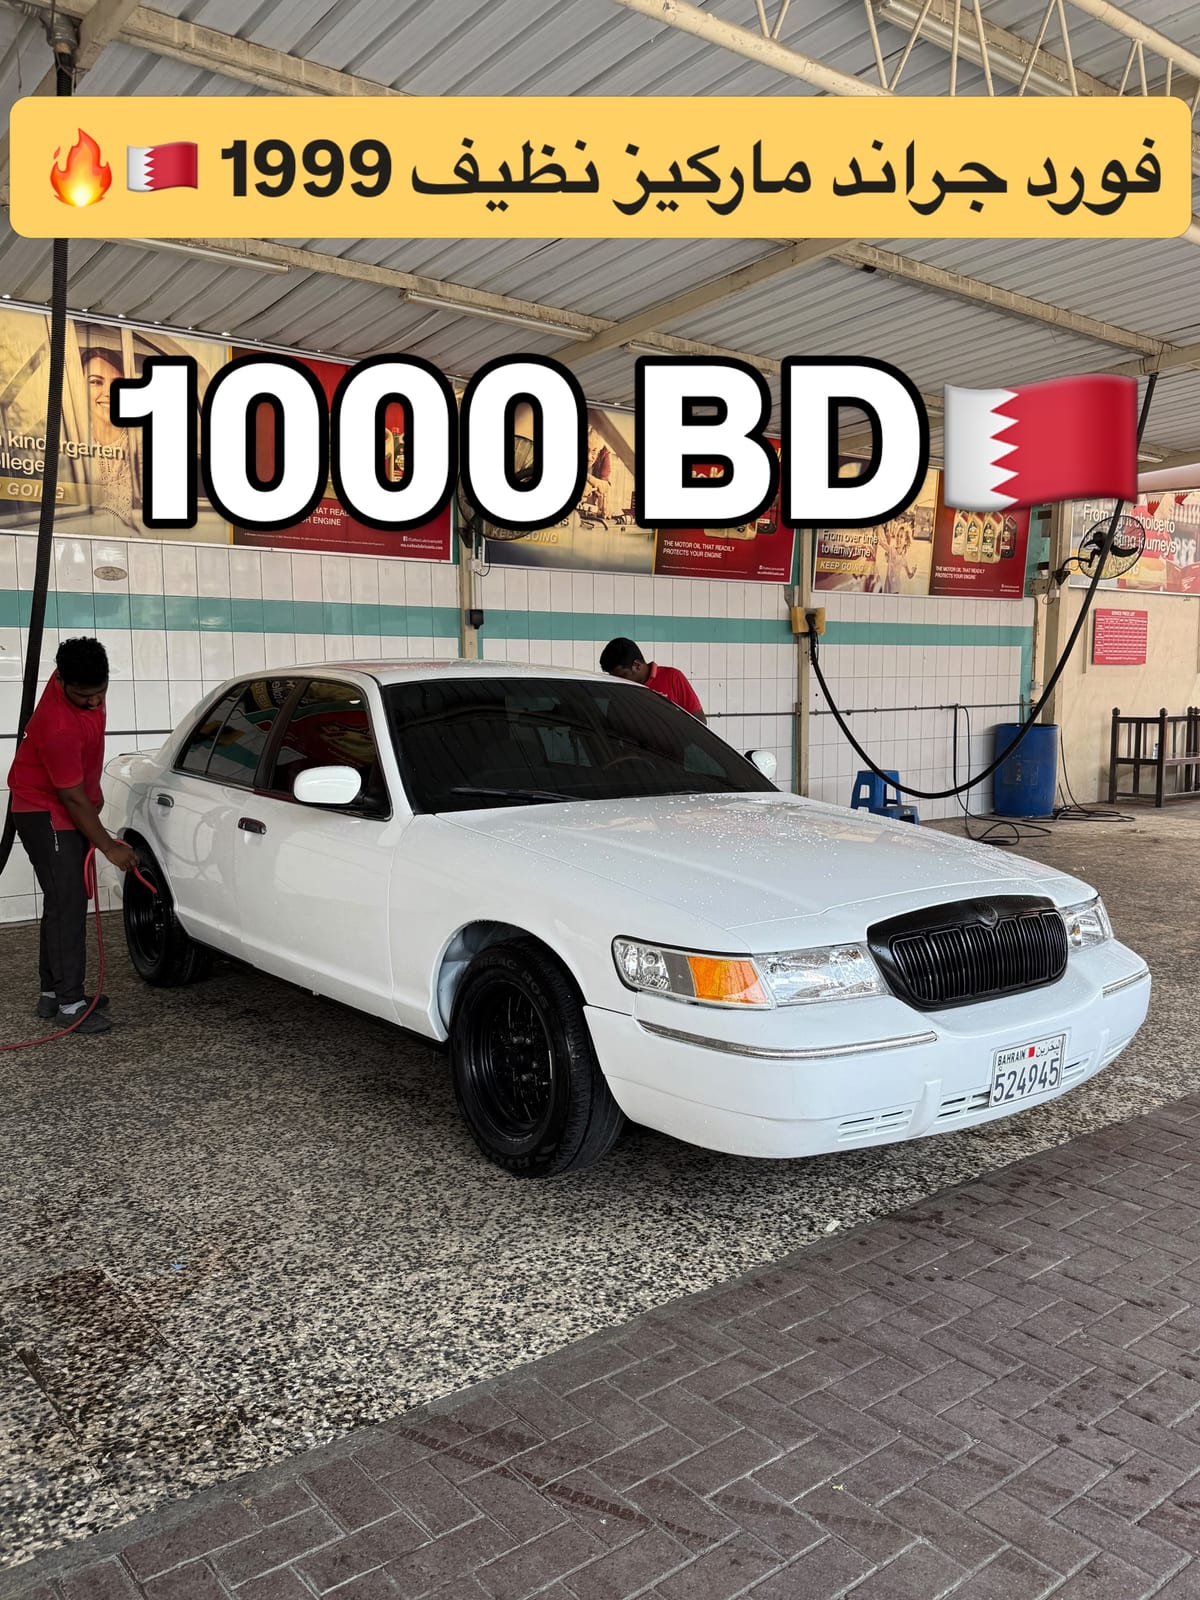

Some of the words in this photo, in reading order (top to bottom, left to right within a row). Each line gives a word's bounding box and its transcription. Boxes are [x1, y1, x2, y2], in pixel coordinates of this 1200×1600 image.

[8, 430, 124, 459] kindrgarten
[0, 453, 45, 475] llege
[7, 482, 65, 499] GOIG
[312, 516, 342, 526] ENGINE
[1083, 503, 1109, 522] From
[1166, 519, 1176, 533] to
[674, 541, 693, 549] MOTOR
[820, 561, 840, 570] KEEP
[998, 1049, 1026, 1066] BAHRAIN
[992, 1057, 1060, 1103] 524945
